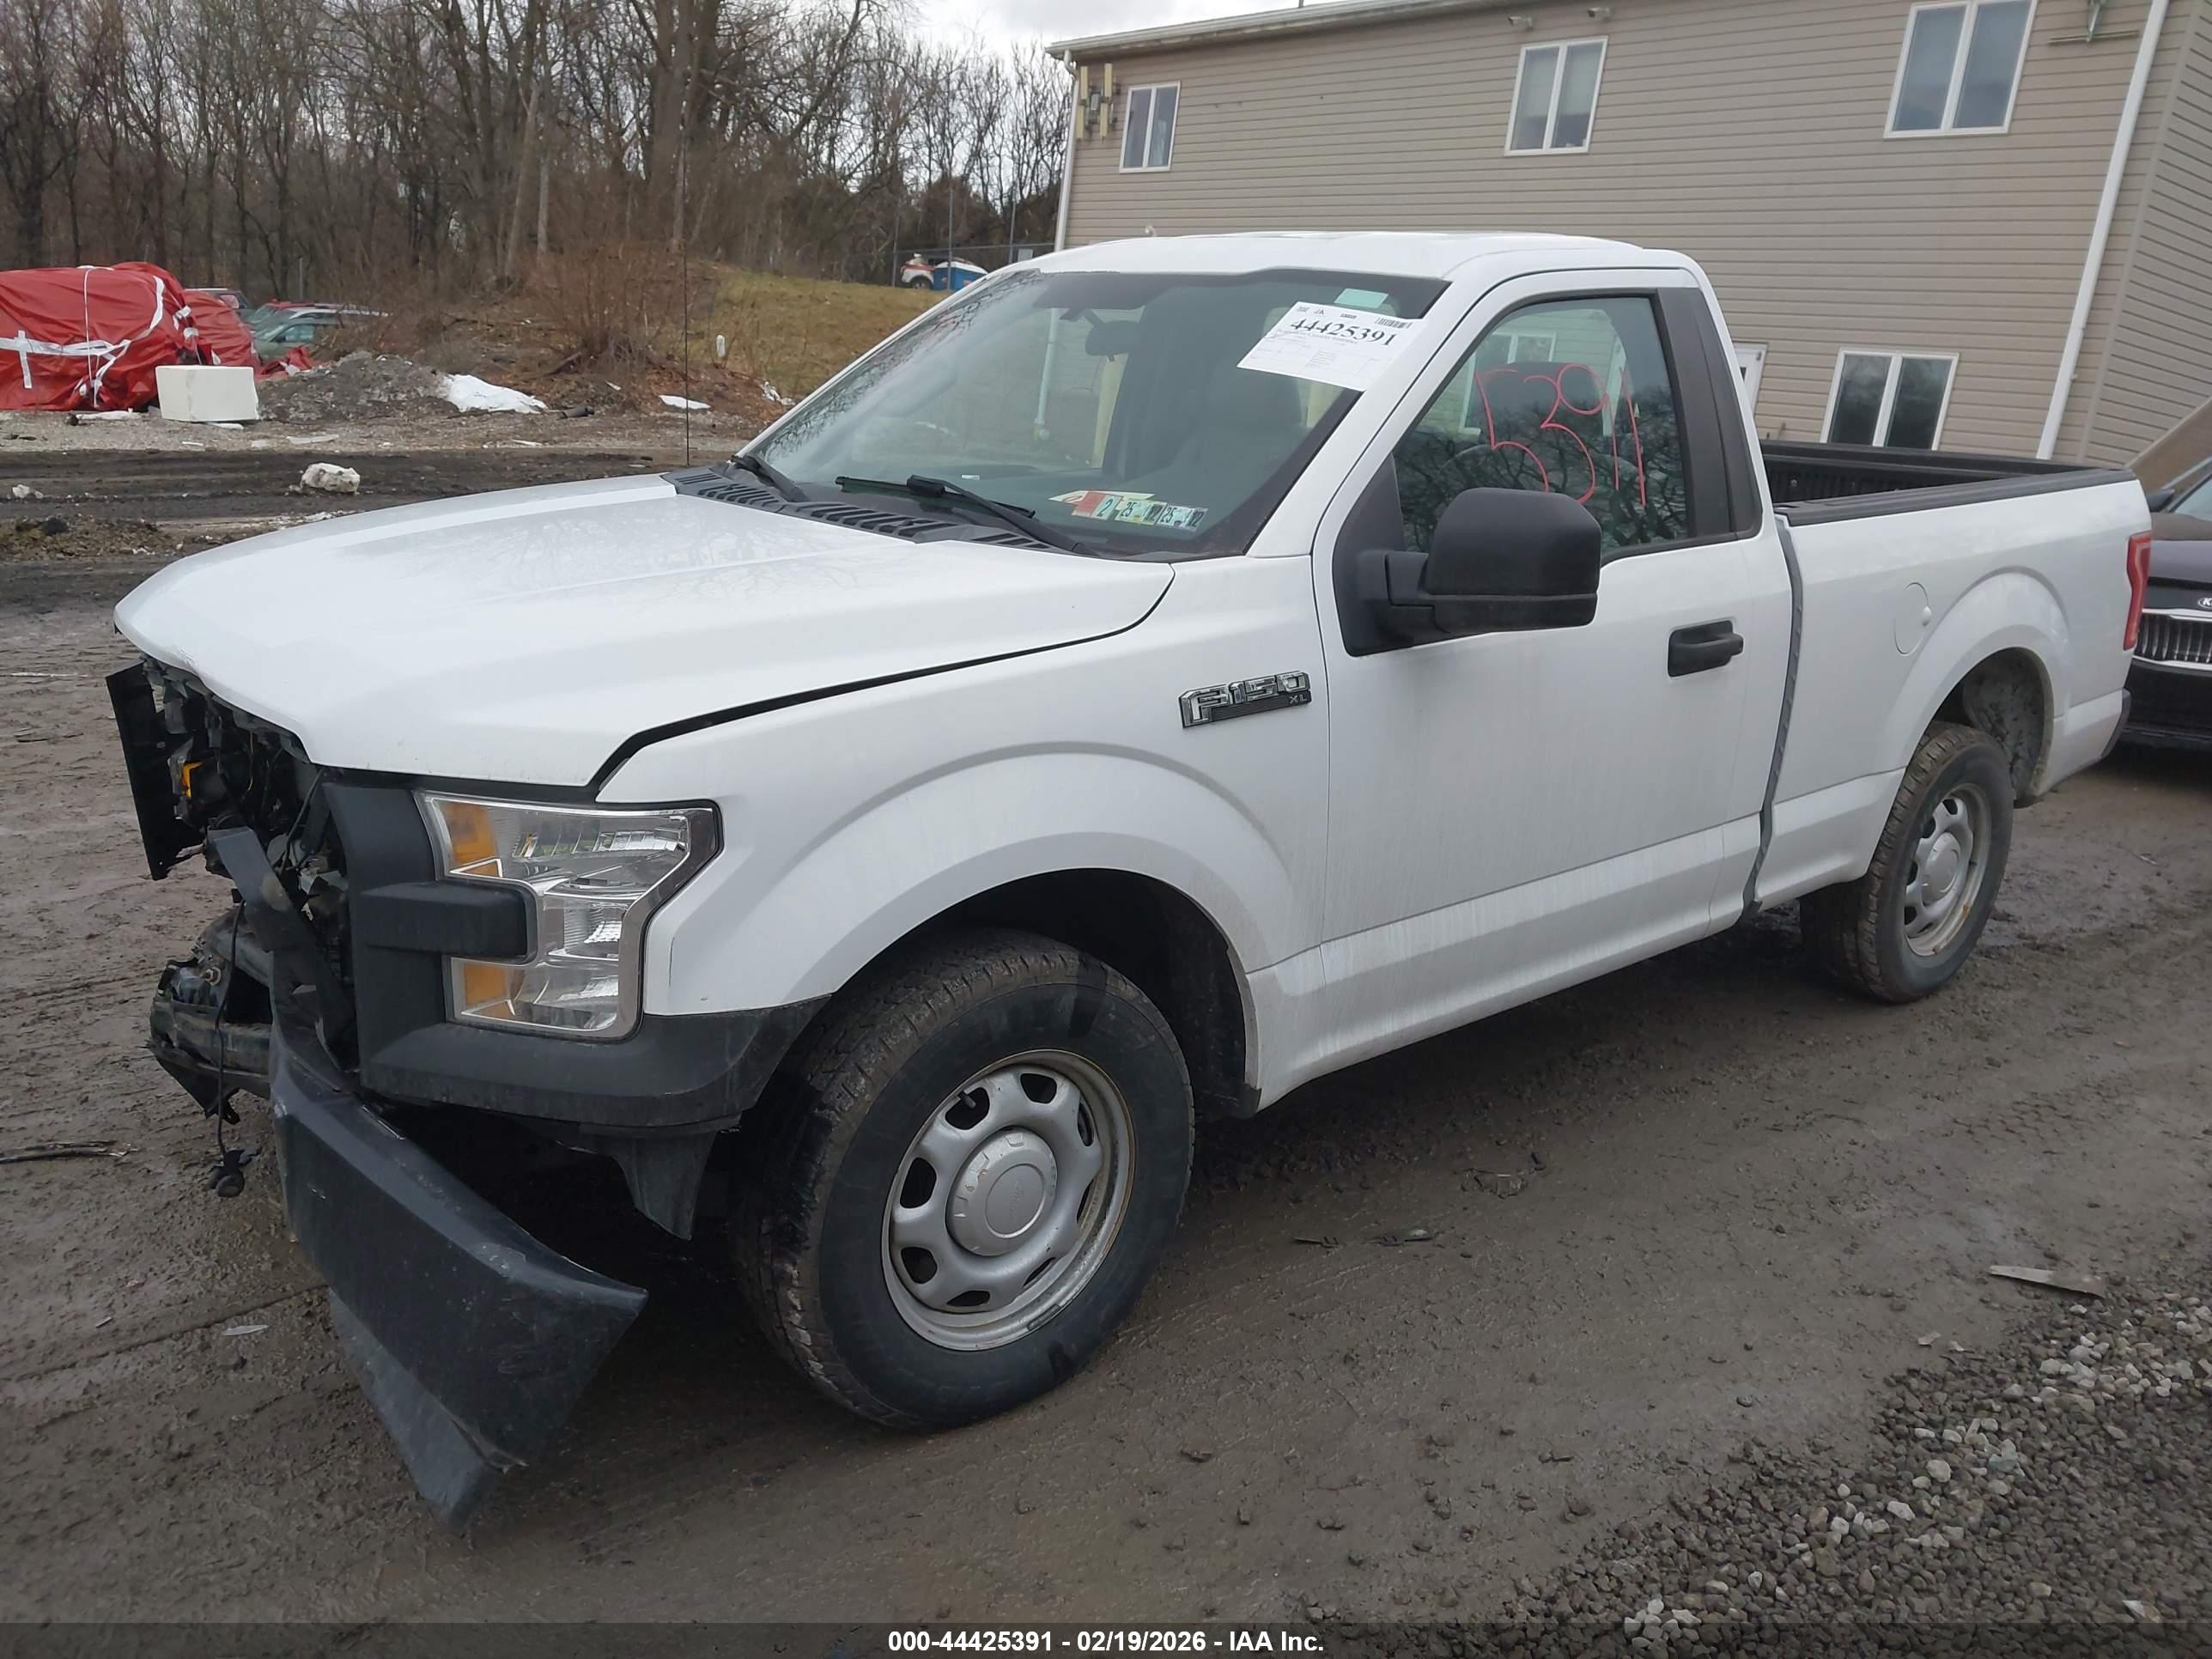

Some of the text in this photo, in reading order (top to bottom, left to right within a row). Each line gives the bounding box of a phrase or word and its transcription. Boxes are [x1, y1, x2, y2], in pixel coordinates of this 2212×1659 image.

[1291, 318, 1396, 345] 44425391
[1096, 498, 1114, 517] 2
[1289, 694, 1308, 705] XL
